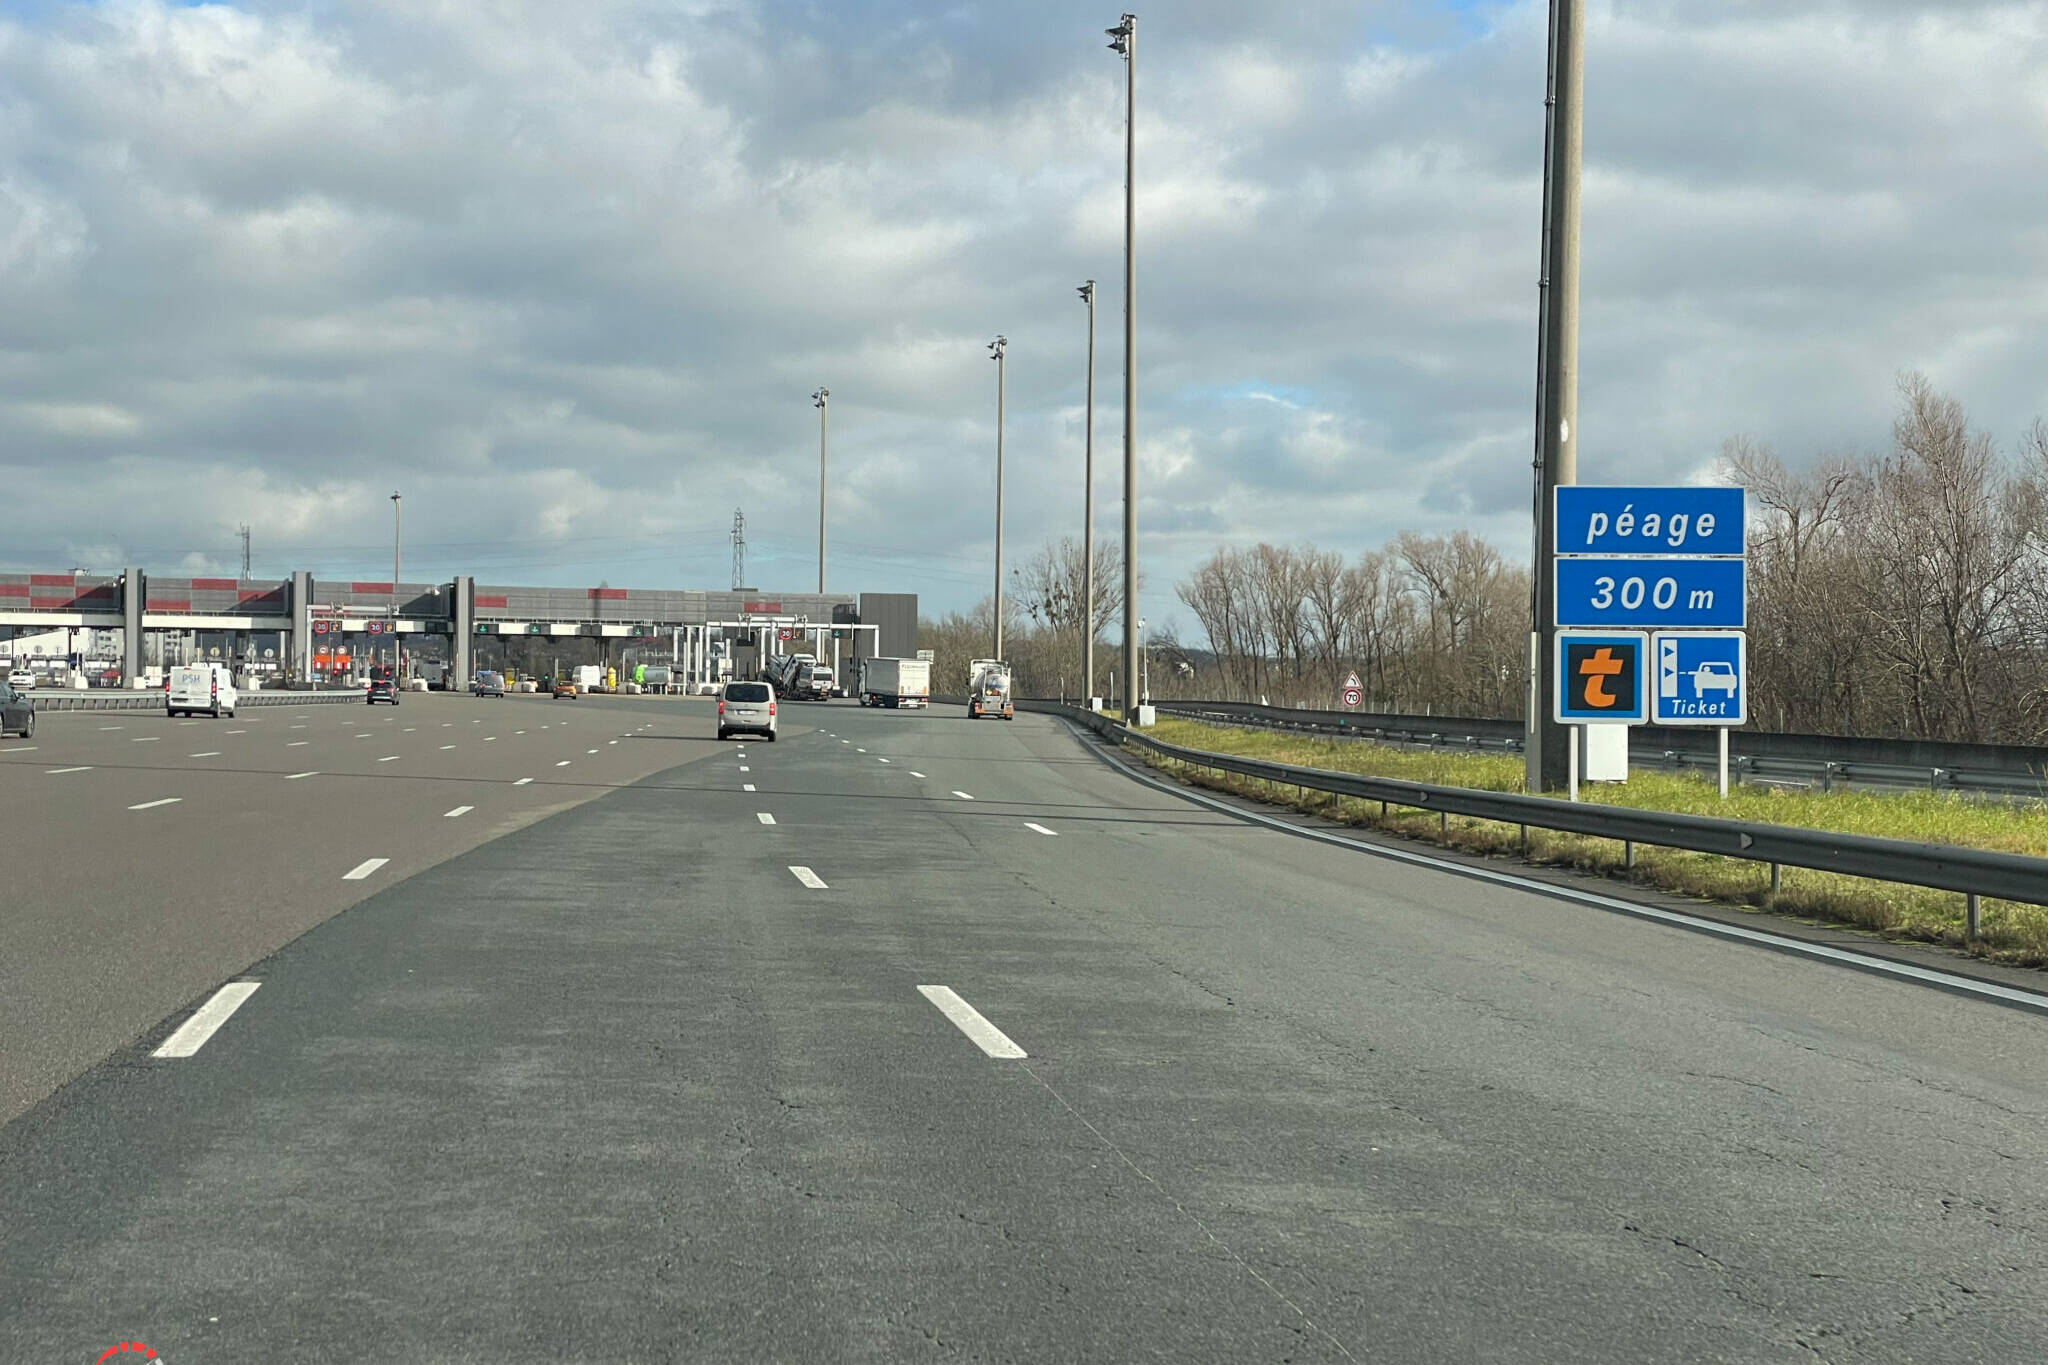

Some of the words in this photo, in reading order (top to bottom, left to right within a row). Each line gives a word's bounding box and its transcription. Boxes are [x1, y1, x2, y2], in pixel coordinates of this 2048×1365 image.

[1586, 503, 1716, 547] péage
[1590, 576, 1678, 610] 300
[1688, 589, 1714, 609] m
[1347, 694, 1358, 702] 70
[1671, 699, 1726, 715] Ticket
